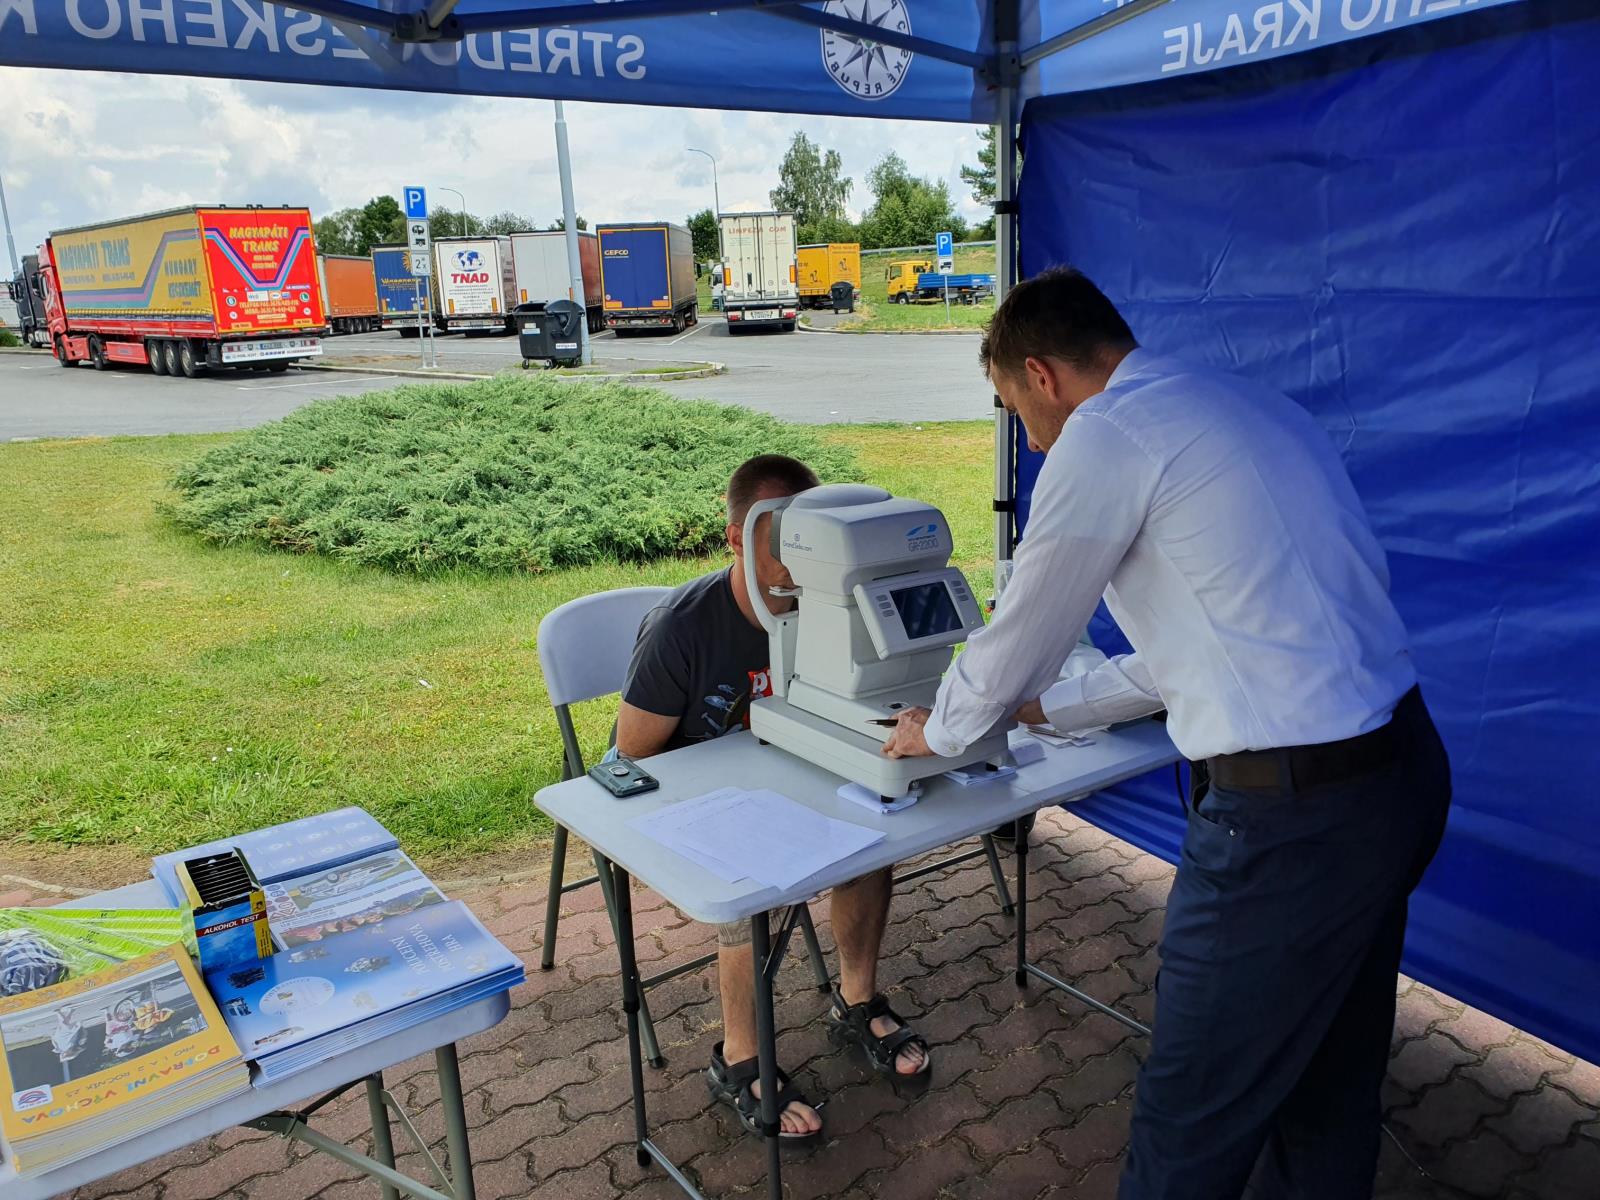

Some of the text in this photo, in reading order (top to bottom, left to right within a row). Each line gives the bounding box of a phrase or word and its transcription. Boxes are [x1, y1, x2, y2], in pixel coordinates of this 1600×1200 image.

[409, 190, 421, 209] P
[241, 240, 280, 253] TRANS
[939, 235, 949, 250] P
[451, 272, 490, 284] TNAD
[203, 913, 260, 936] ALKOHOL TEST
[442, 934, 464, 952] HRA
